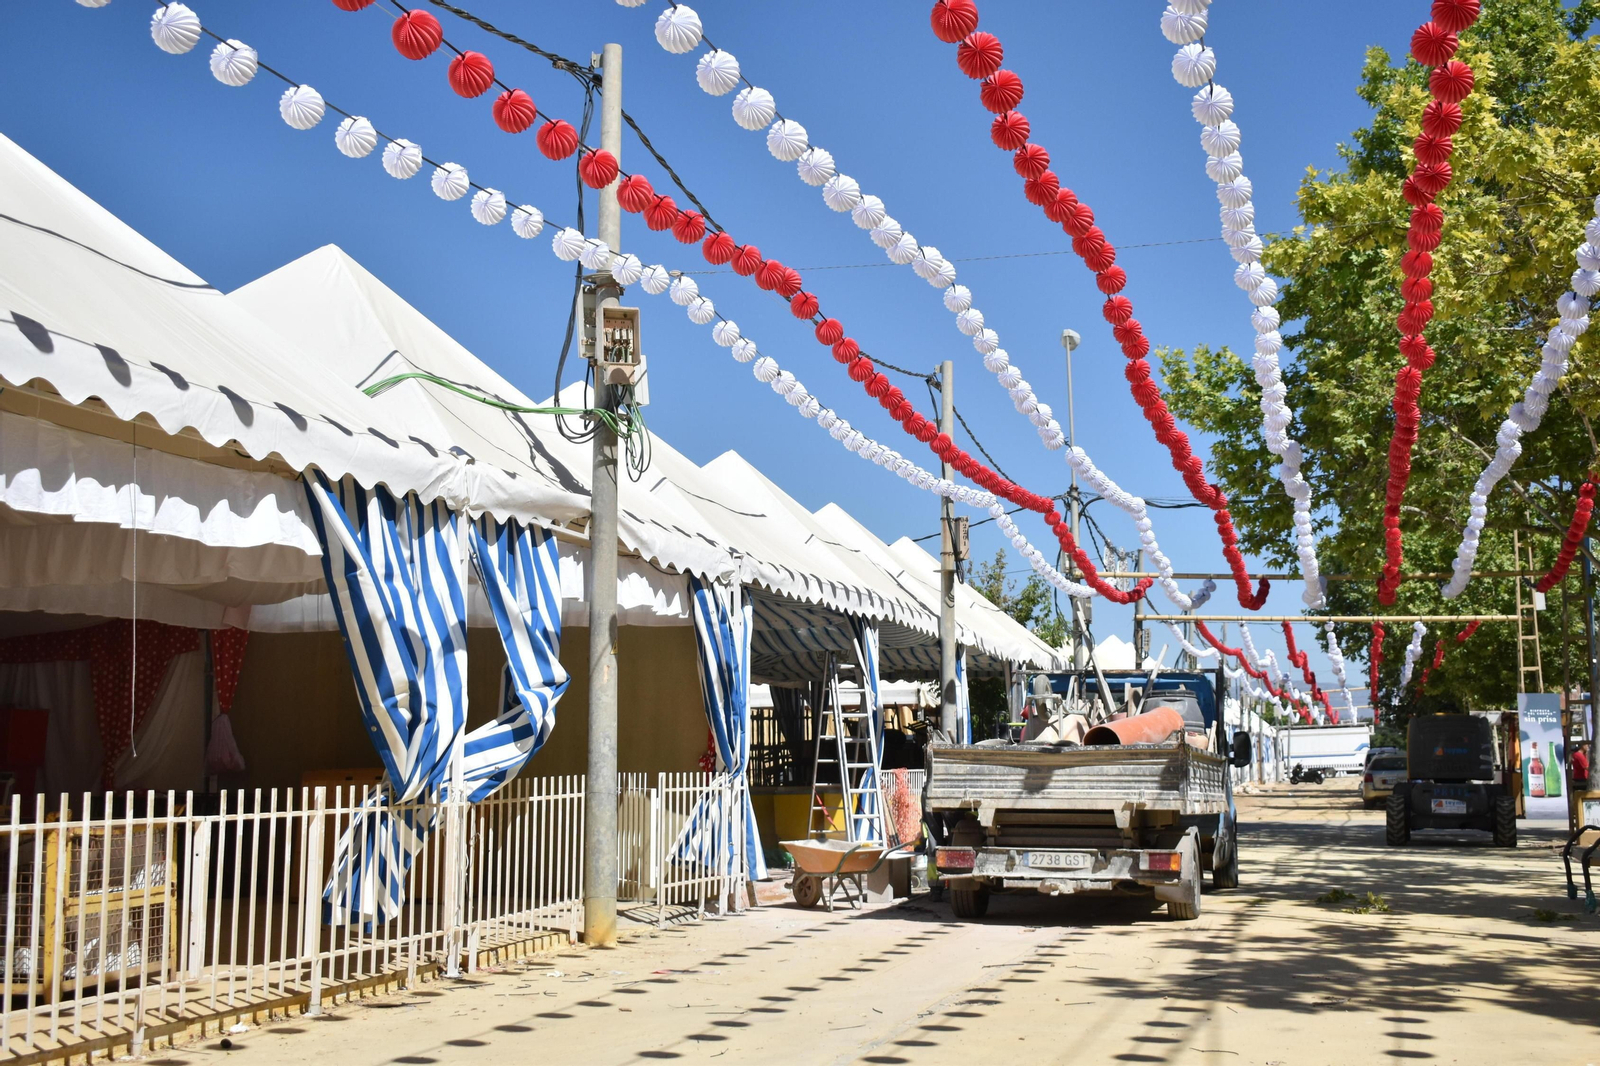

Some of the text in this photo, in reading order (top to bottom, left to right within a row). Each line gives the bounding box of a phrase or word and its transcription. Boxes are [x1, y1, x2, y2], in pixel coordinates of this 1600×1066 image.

[1537, 715, 1557, 725] prisa
[1032, 854, 1087, 866] 2738 GST
